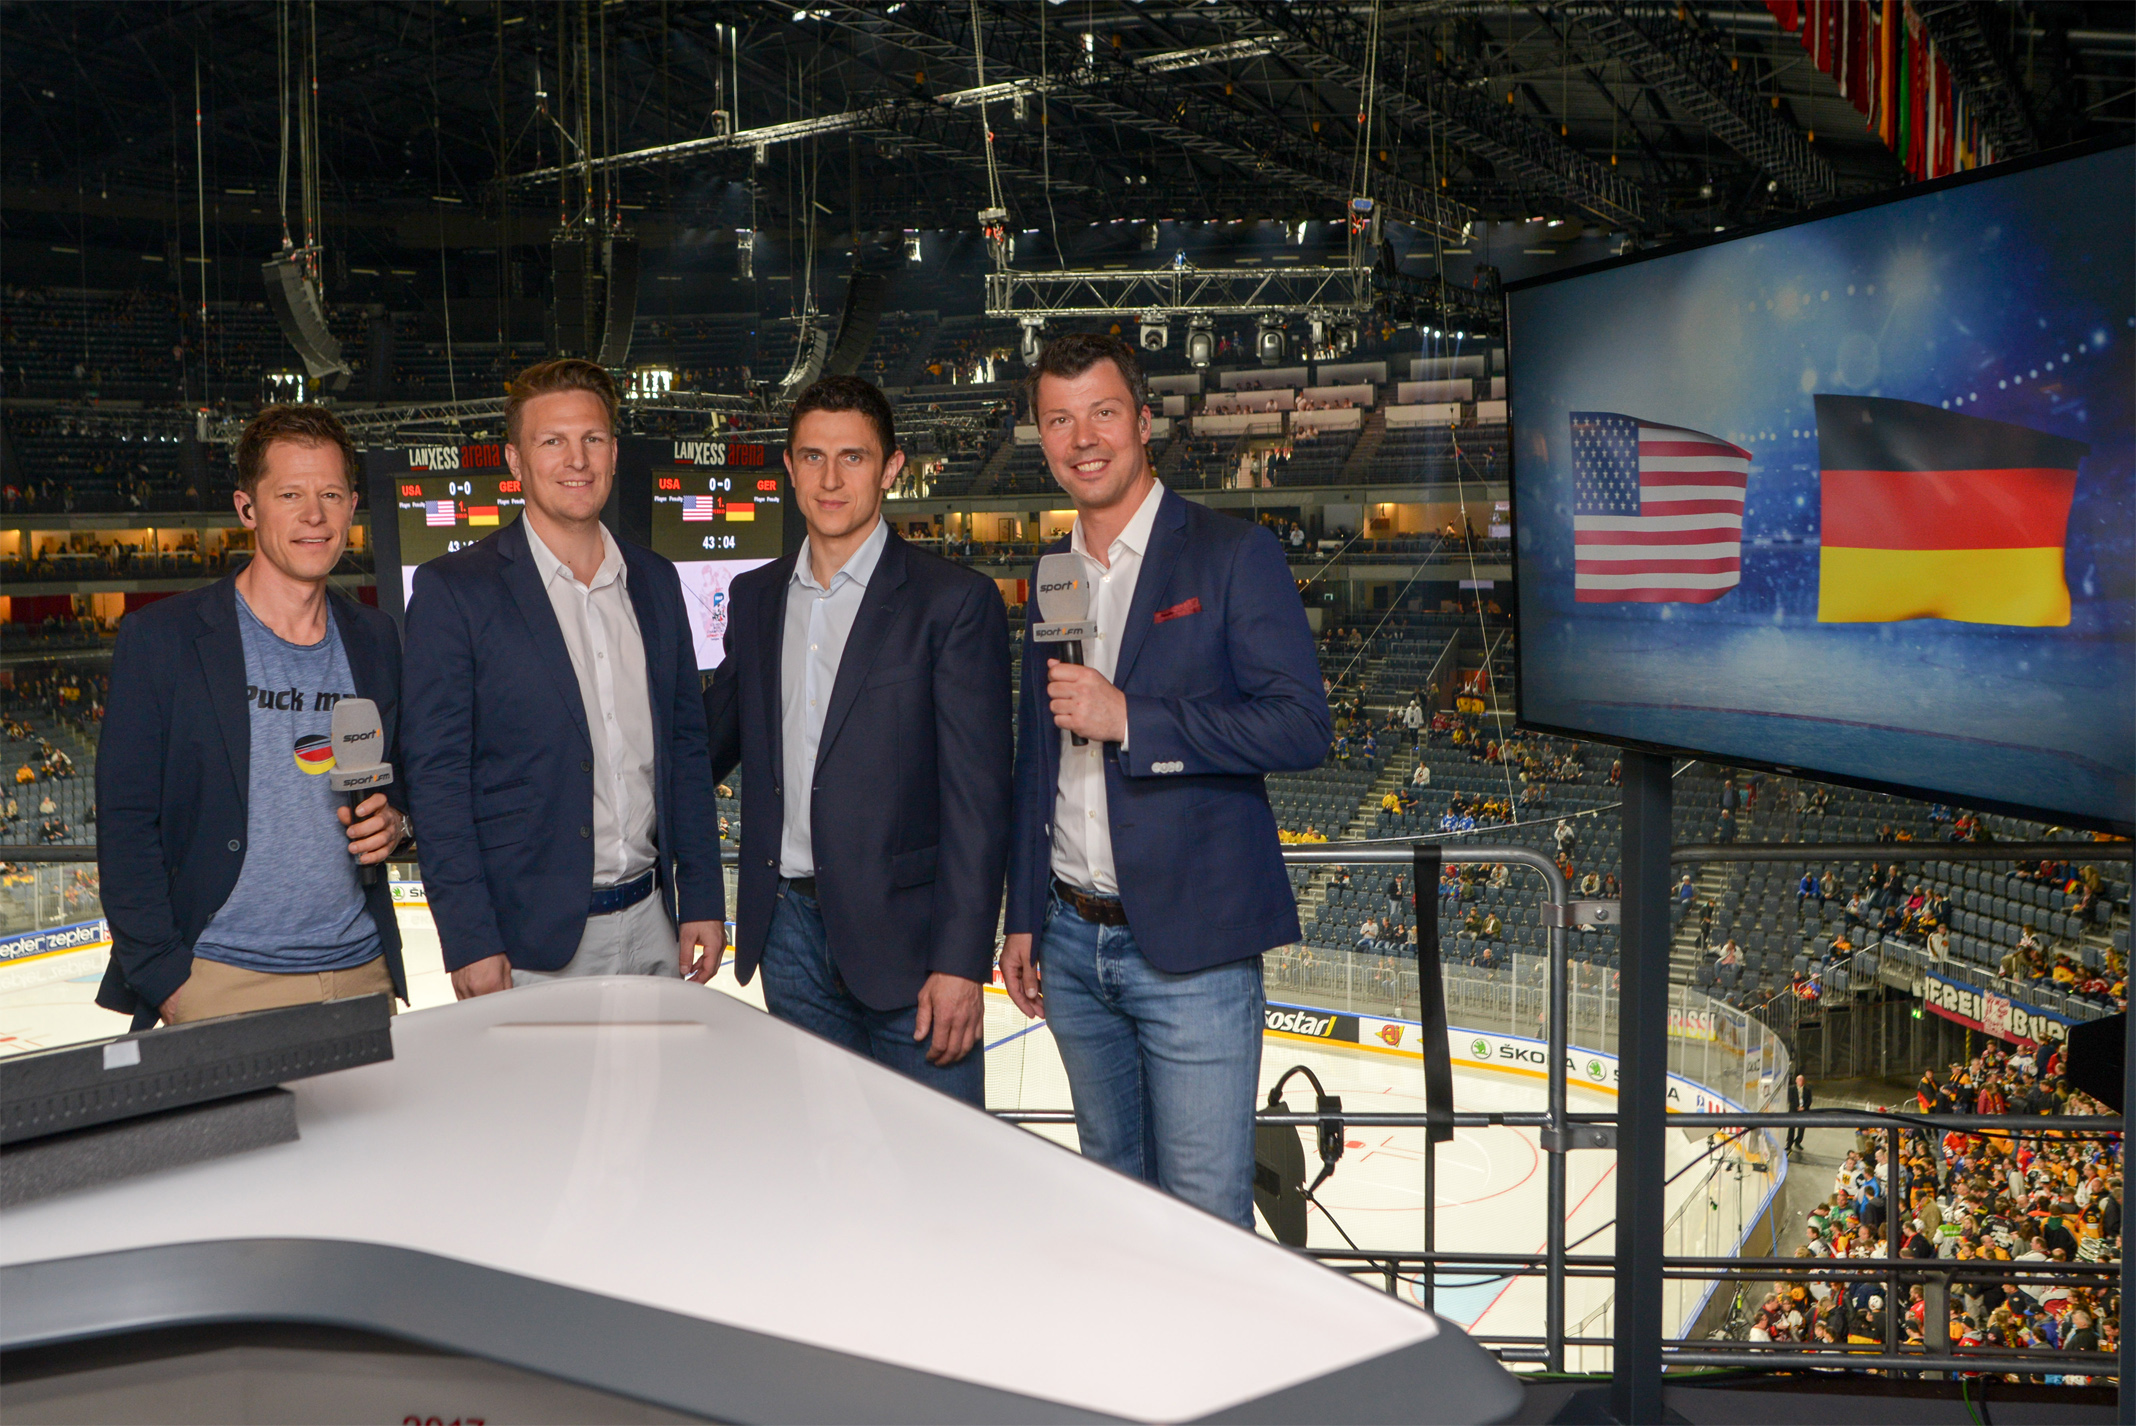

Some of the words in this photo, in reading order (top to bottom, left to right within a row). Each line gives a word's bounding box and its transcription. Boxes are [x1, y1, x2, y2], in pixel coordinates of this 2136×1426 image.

[409, 445, 460, 471] LANXESS
[461, 444, 500, 468] arena
[674, 441, 726, 466] LANXESS
[727, 443, 765, 466] arena
[401, 484, 422, 497] USA
[448, 481, 472, 496] 0-0
[499, 480, 522, 493] GER
[658, 478, 681, 490] USA
[708, 477, 731, 492] 0-0
[756, 480, 777, 491] GER
[1039, 580, 1079, 594] sport1
[343, 728, 381, 743] sport1
[46, 926, 100, 948] zepter
[1499, 1043, 1577, 1071] ŠKOA
